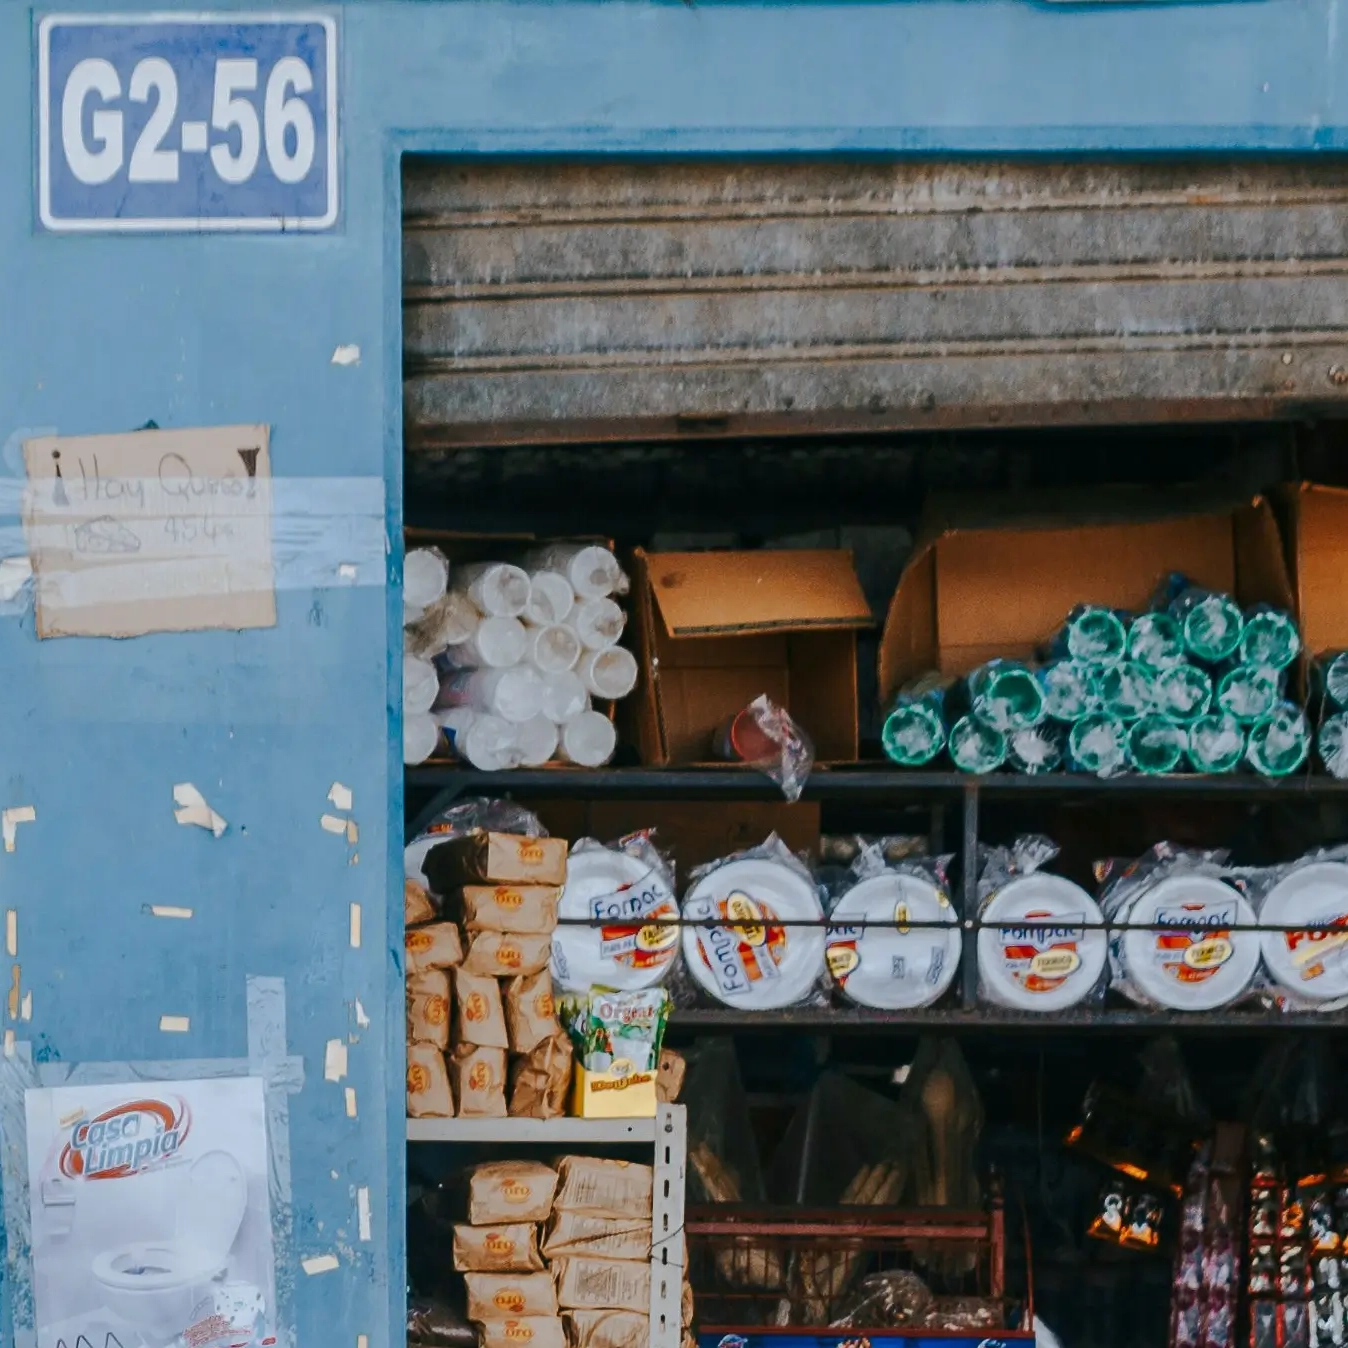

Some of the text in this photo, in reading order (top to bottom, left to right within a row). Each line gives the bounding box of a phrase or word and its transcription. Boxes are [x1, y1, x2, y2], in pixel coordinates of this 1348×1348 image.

[62, 56, 316, 185] G2-56
[71, 1112, 141, 1149] Casa
[84, 1126, 179, 1175] Limpia
